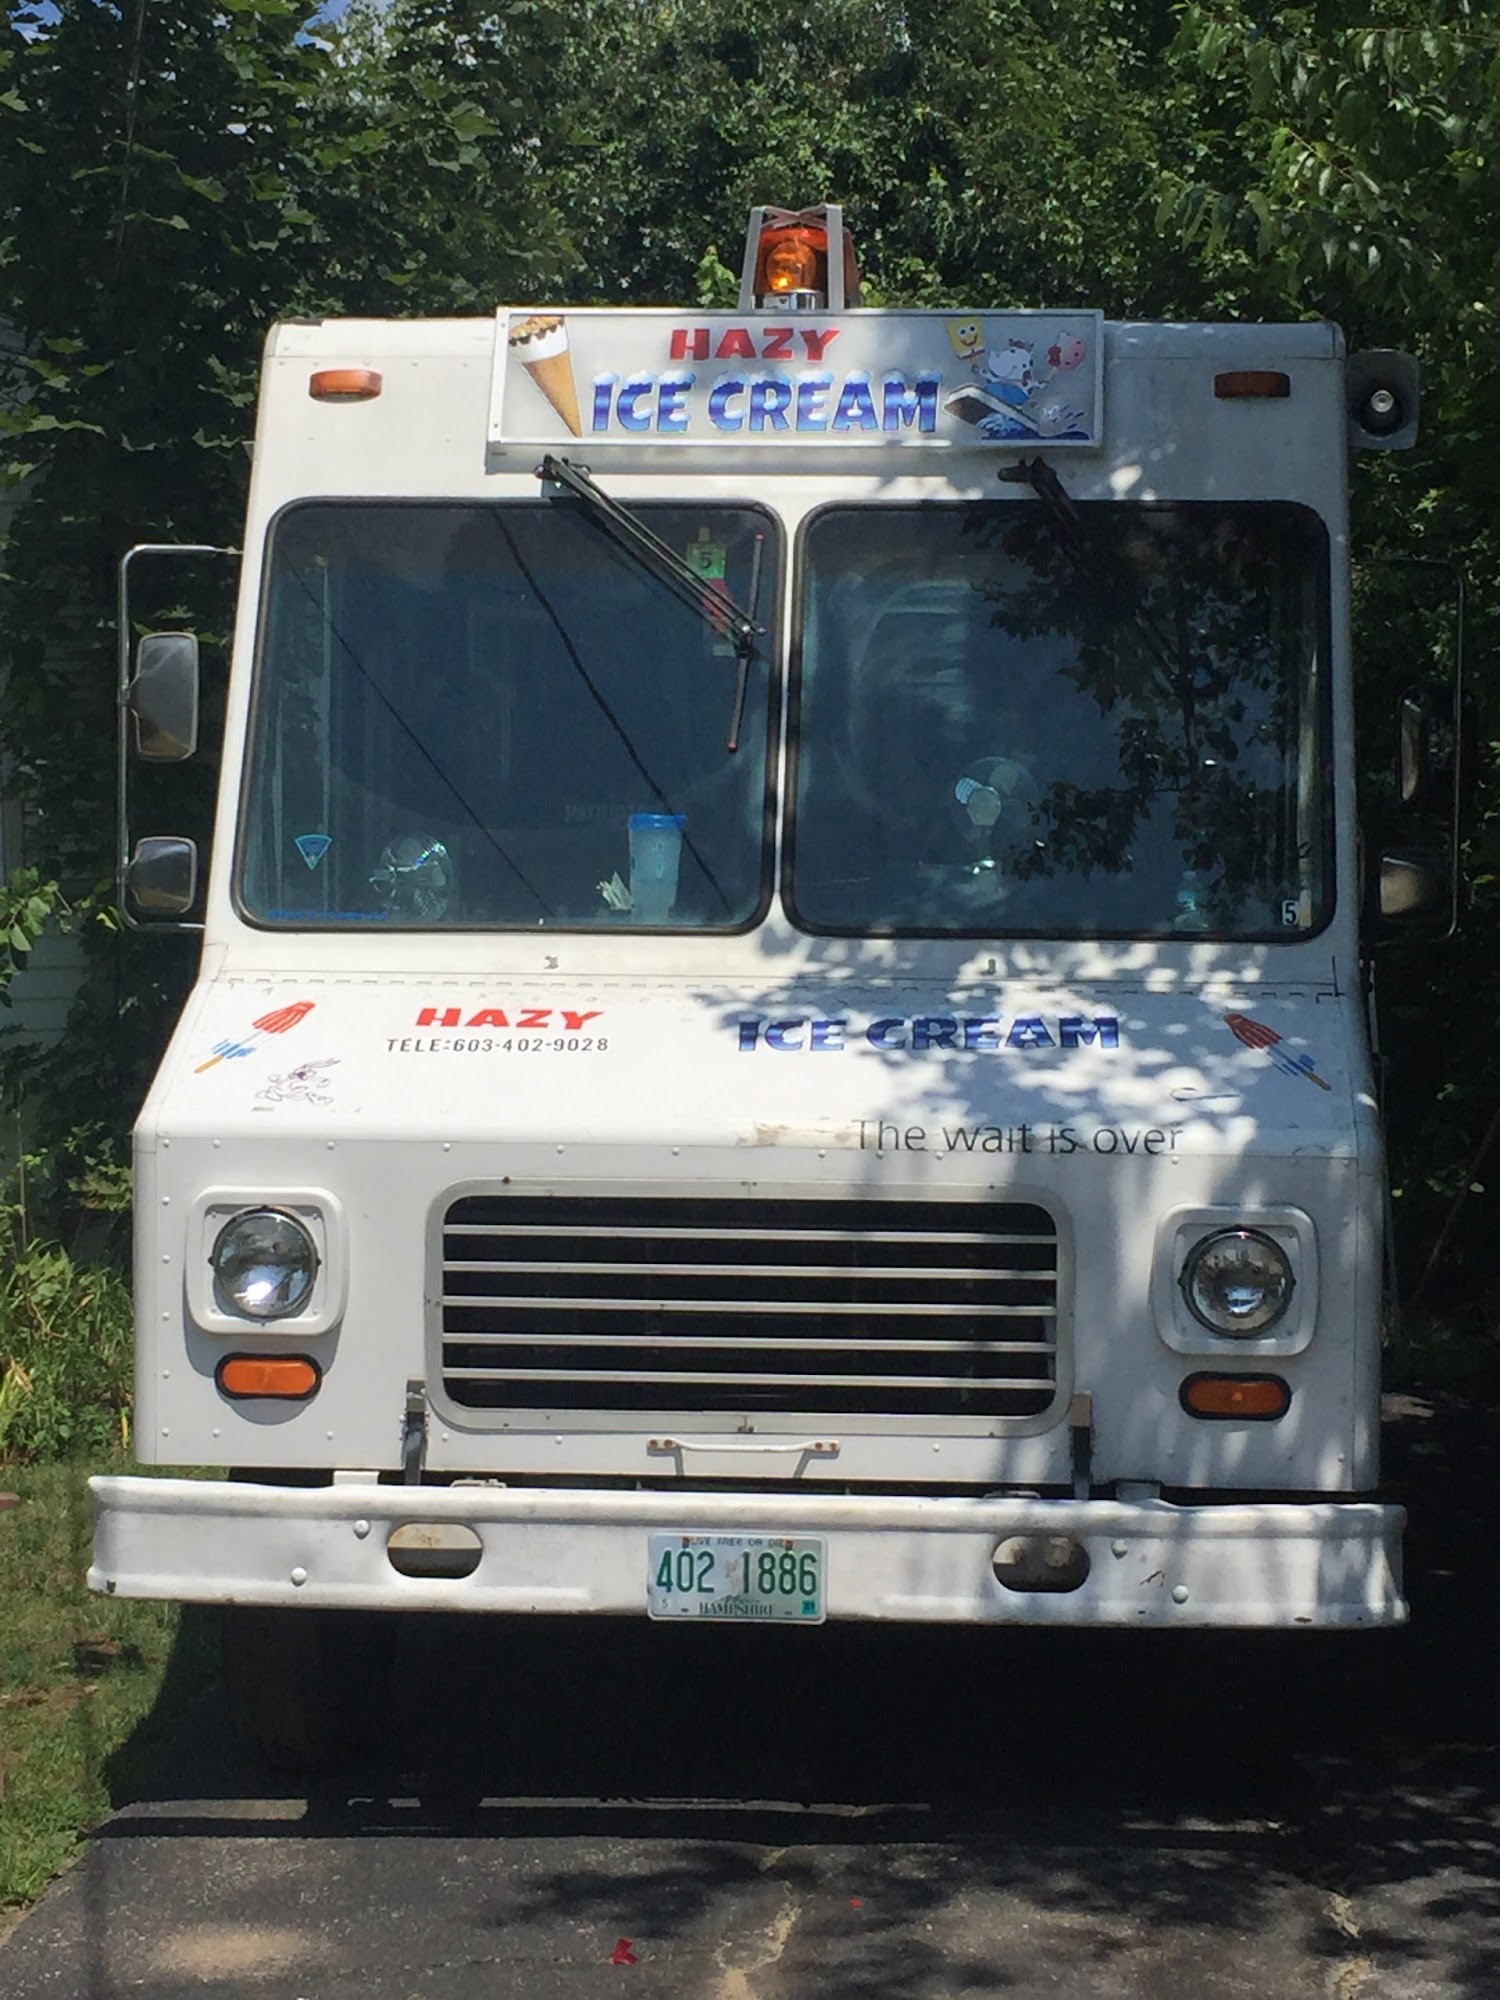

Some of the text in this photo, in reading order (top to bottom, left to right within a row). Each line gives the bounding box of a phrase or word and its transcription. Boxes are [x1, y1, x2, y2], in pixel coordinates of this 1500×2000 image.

[669, 328, 840, 361] HAZY
[592, 370, 942, 433] ICE CREAM
[701, 552, 712, 569] 5
[1285, 902, 1297, 924] 5
[415, 1007, 606, 1030] HAZY
[738, 1016, 1120, 1051] ICE CREAM
[386, 1037, 609, 1054] TELE:603-402-9028
[851, 1119, 1184, 1154] The wait is over
[656, 1550, 817, 1596] 402 1886
